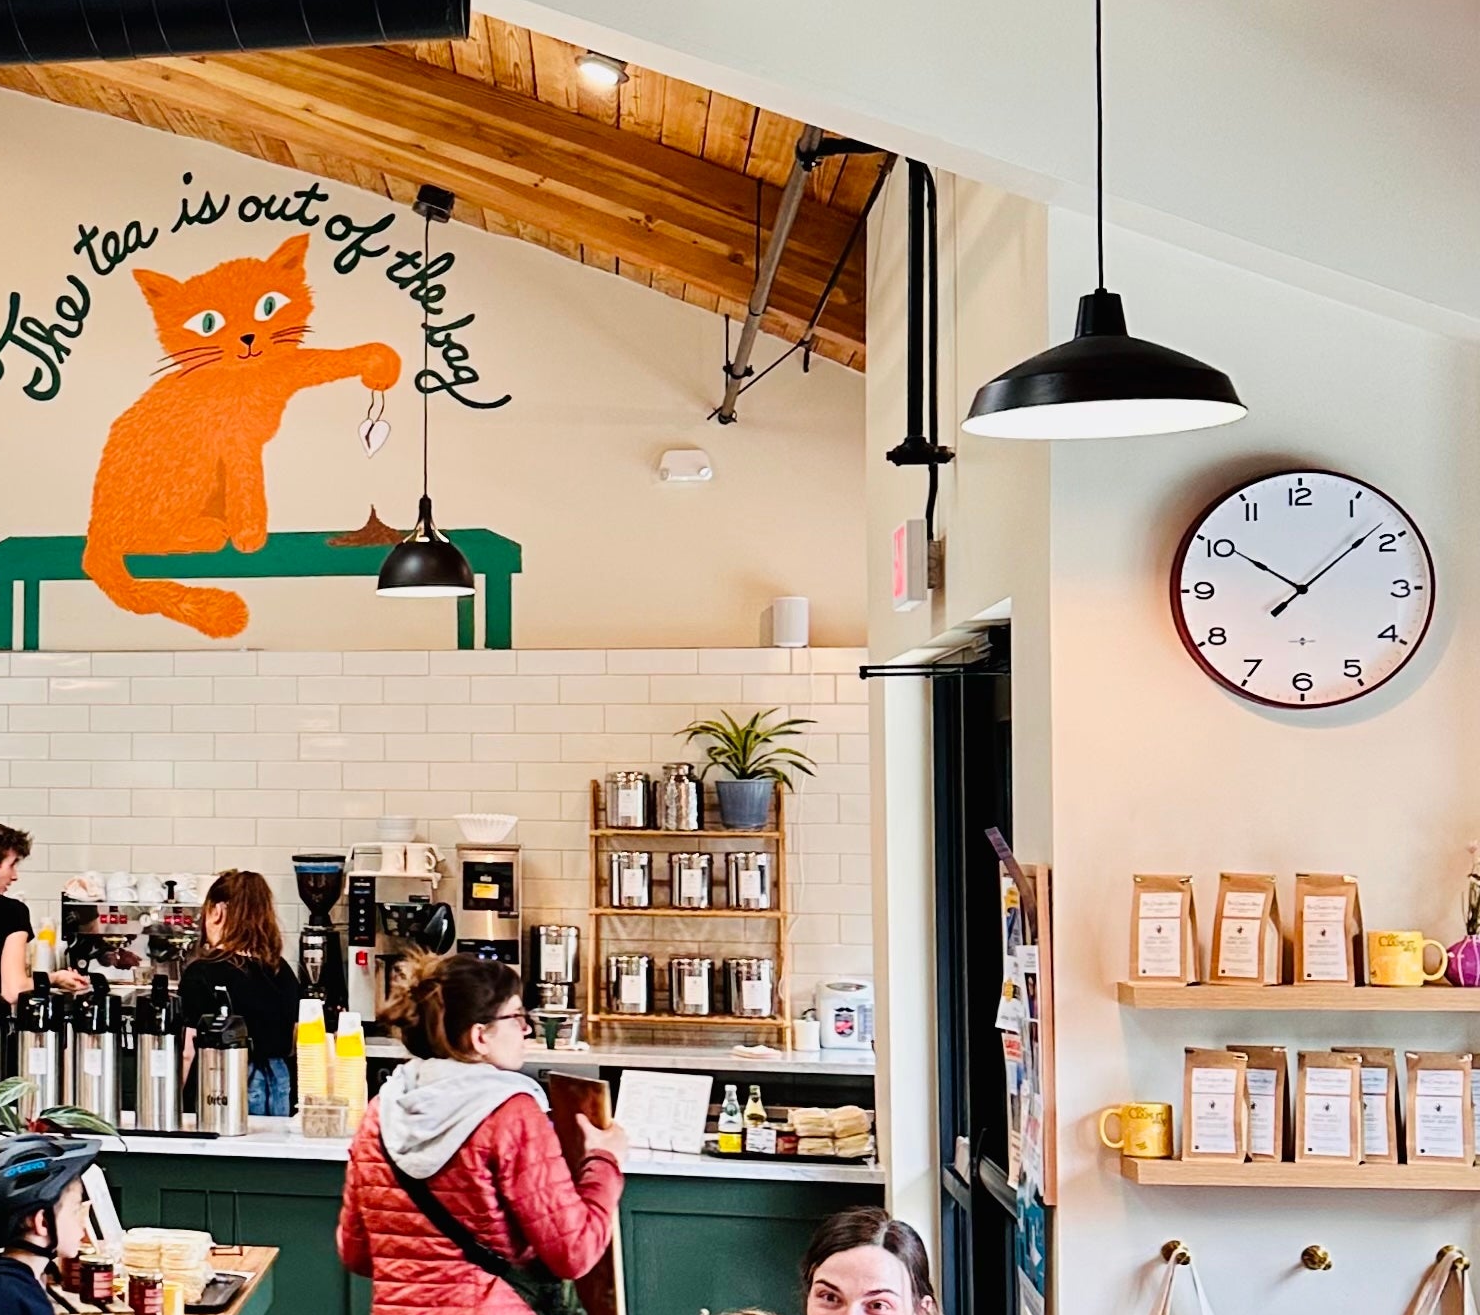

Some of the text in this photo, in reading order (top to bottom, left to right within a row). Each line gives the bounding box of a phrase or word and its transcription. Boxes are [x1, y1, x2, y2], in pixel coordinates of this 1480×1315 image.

[171, 171, 230, 233] is
[238, 182, 329, 228] out
[73, 220, 159, 274] tea
[323, 214, 396, 274] of
[386, 250, 455, 315] the
[413, 312, 513, 409] bag
[1288, 487, 1313, 506] 12
[1245, 502, 1258, 521] 11
[1207, 538, 1235, 558] 10
[1378, 533, 1397, 552] 2
[1193, 581, 1215, 600] 9
[1390, 579, 1411, 598] 3
[1207, 627, 1227, 645] 8
[1377, 624, 1399, 643] 4
[1243, 658, 1263, 678] 7
[1343, 659, 1362, 677] 5
[1291, 672, 1313, 691] 6
